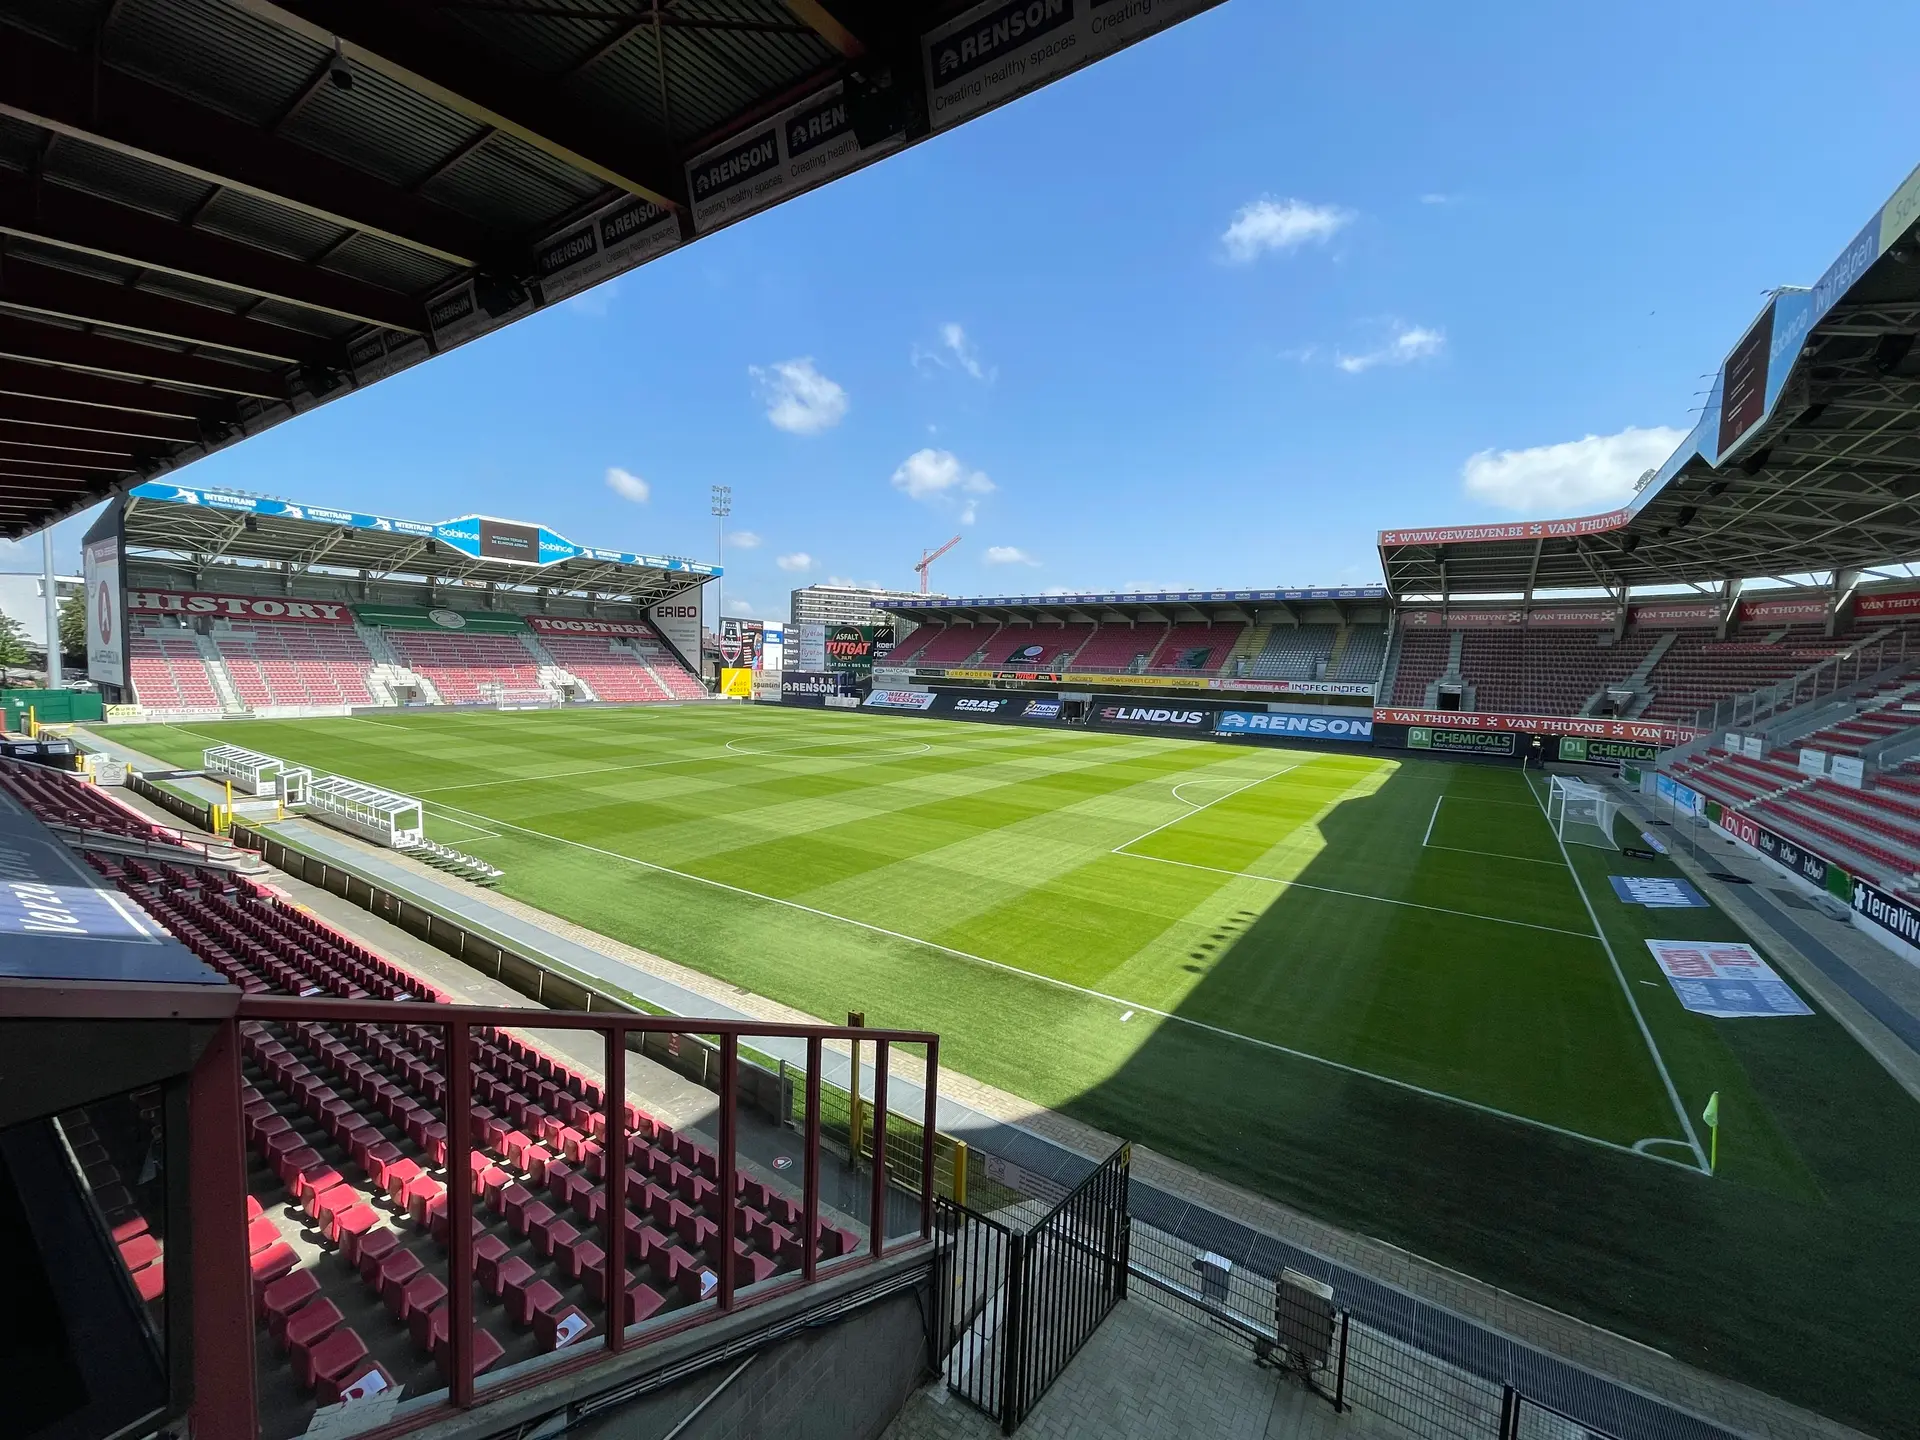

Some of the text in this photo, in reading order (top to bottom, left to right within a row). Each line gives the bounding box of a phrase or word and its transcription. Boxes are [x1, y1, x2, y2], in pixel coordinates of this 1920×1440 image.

[1091, 0, 1151, 34] Creating
[960, 0, 1064, 63] RENSON
[935, 33, 1076, 111] Creating healthy spaces
[808, 103, 848, 137] REN
[709, 140, 773, 187] RENSON
[791, 137, 859, 178] Creating healthy
[697, 173, 783, 221] Creating healthy spaces
[615, 203, 665, 236] RENSON
[550, 232, 593, 269] RENSON
[203, 493, 257, 507] INTERTRANS
[307, 508, 352, 520] INTERTRANS
[1547, 513, 1622, 535] VAN THUYNE
[438, 527, 480, 540] Sobinco
[1400, 526, 1524, 543] WWW.GEWELVEN.BE
[540, 541, 574, 554] Sobinco
[128, 591, 343, 620] HISTORY
[1745, 604, 1821, 616] VAN THUYNE
[1861, 599, 1920, 610] VAN THUY
[657, 606, 697, 618] ERIBO
[1449, 613, 1507, 622] VAN THUYNE
[1533, 612, 1599, 621] VAN THUYNE
[1634, 609, 1706, 620] VAN THUYNE
[535, 619, 652, 635] TOGETHER
[836, 633, 859, 641] ASFALT
[826, 642, 871, 655] TUTGAT
[792, 682, 835, 694] RENSON
[954, 706, 997, 714] WOODSHOPS
[957, 699, 1000, 709] CRAS
[1034, 704, 1058, 713] Hubo
[1100, 706, 1203, 724] ELINDUS
[1392, 712, 1480, 726] VAN THUYNE
[1250, 715, 1373, 736] RENSON
[1505, 719, 1605, 734] VAN THUYNE
[1413, 731, 1428, 741] DL
[1433, 732, 1511, 747] CHEMICALS
[1631, 727, 1661, 739] VAN
[1564, 741, 1584, 753] DL
[1866, 889, 1920, 944] TerraViv
